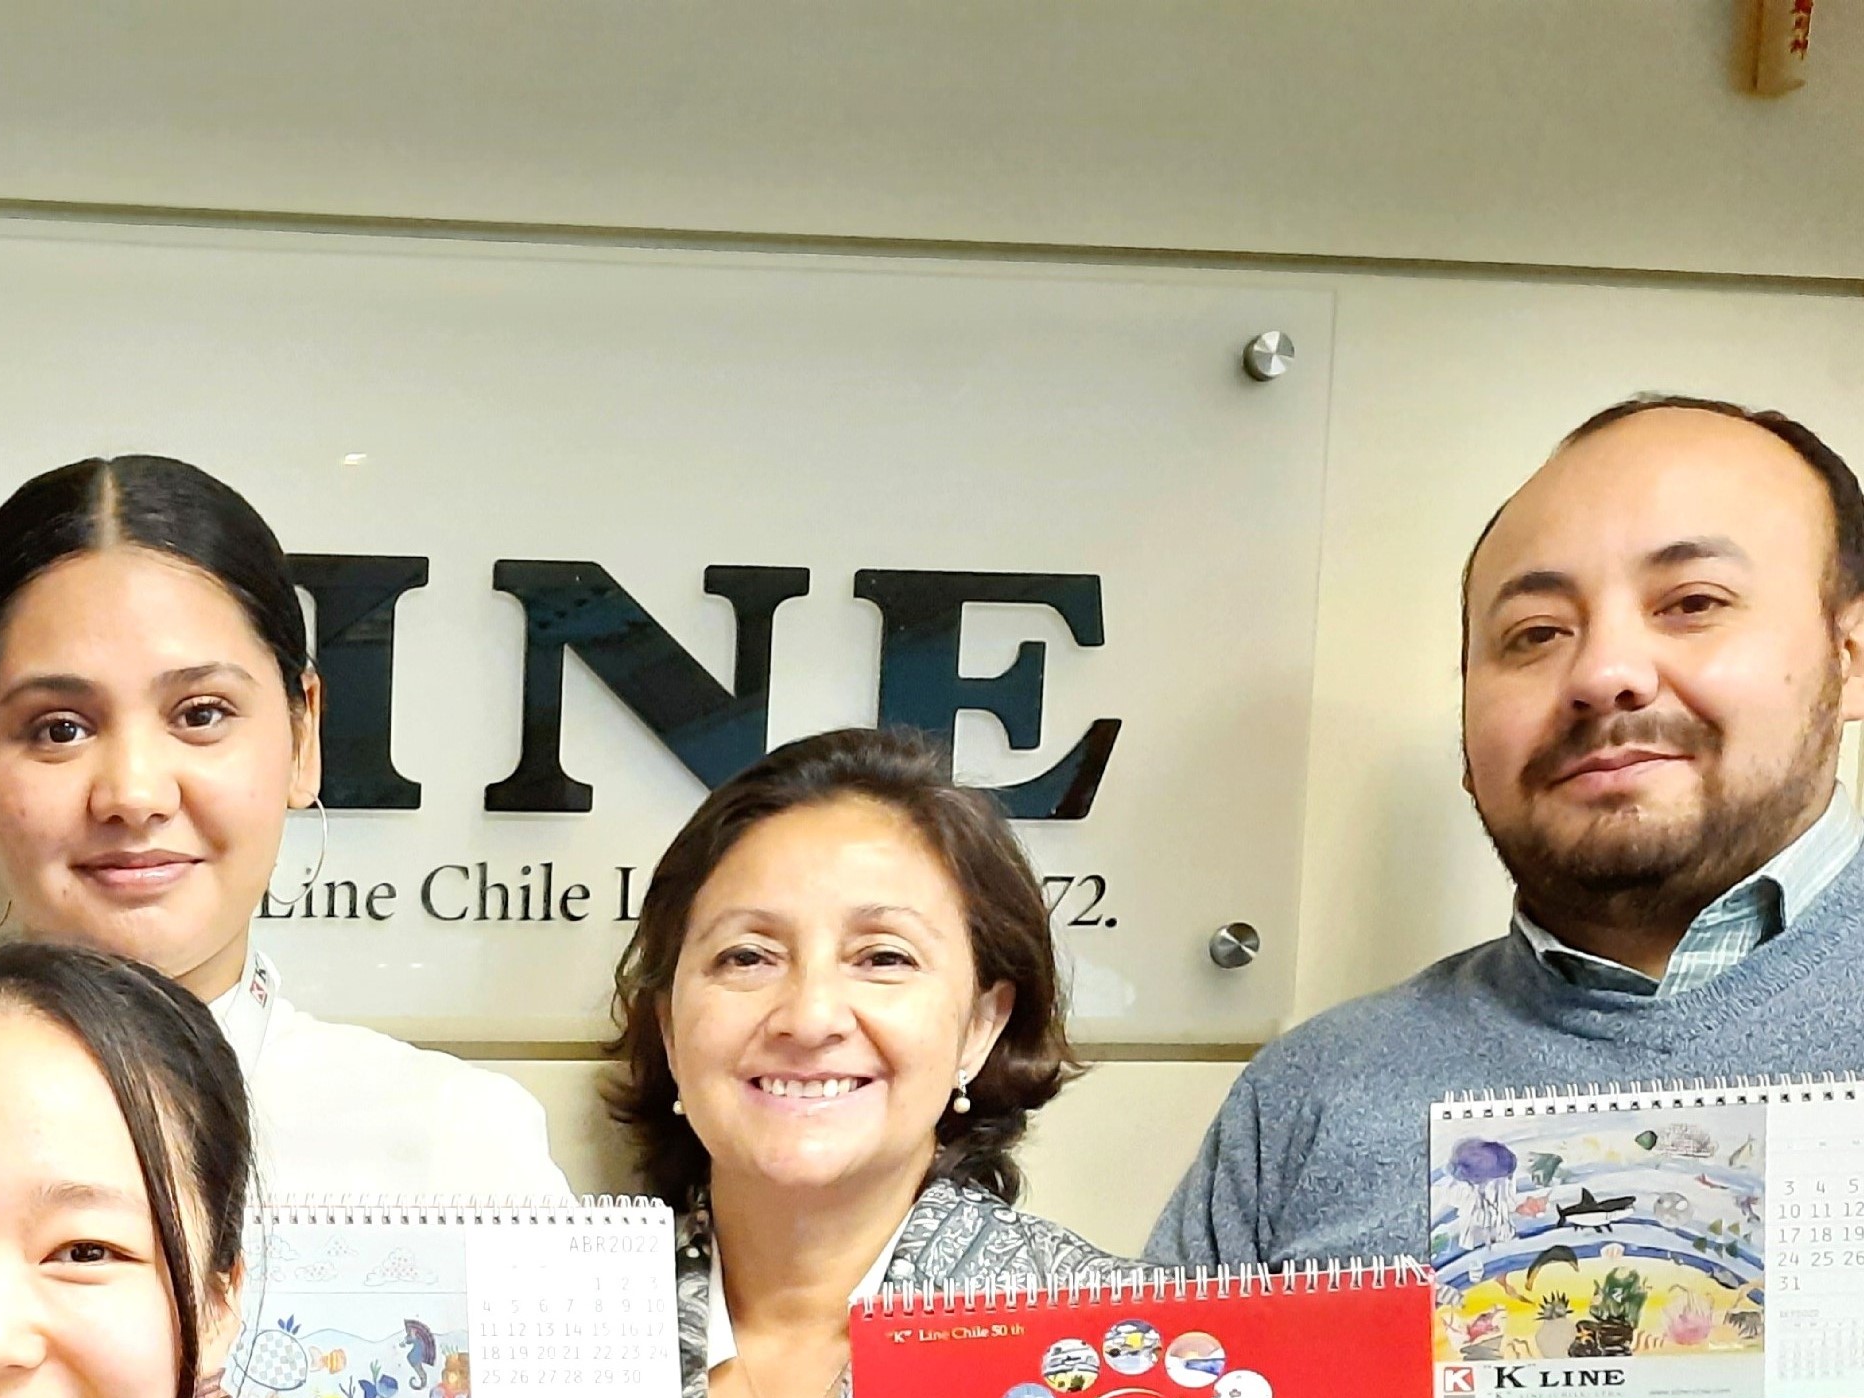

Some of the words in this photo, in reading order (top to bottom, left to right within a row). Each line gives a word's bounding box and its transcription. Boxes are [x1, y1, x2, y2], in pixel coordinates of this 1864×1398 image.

[420, 861, 591, 922] Chile
[1784, 1181, 1794, 1196] 3
[1816, 1181, 1825, 1194] 4
[1849, 1178, 1858, 1193] 5
[1778, 1204, 1800, 1219] 10
[1811, 1203, 1831, 1218] 11
[1779, 1227, 1800, 1243] 17
[1810, 1227, 1832, 1243] 18
[569, 1235, 659, 1253] ABR2022
[1777, 1252, 1799, 1267] 24
[1811, 1251, 1833, 1267] 25
[1779, 1276, 1800, 1291] 31
[483, 1300, 490, 1313] 4
[512, 1300, 519, 1313] 5
[539, 1299, 548, 1312] 6
[568, 1299, 573, 1312] 7
[595, 1299, 603, 1312] 8
[622, 1299, 630, 1312] 9
[481, 1323, 498, 1336] 11
[508, 1323, 526, 1336] 12
[537, 1323, 554, 1336] 13
[565, 1323, 581, 1336] 14
[919, 1329, 950, 1342] Line
[951, 1325, 990, 1339] Chile
[991, 1324, 1008, 1337] 50
[1011, 1323, 1025, 1336] th
[482, 1346, 500, 1360] 18
[510, 1346, 528, 1360] 19
[538, 1346, 555, 1359] 20
[563, 1346, 580, 1359] 21
[482, 1370, 500, 1384] 25
[510, 1370, 528, 1384] 26
[539, 1370, 556, 1384] 27
[564, 1370, 583, 1384] 28
[594, 1370, 613, 1384] 29
[623, 1370, 640, 1383] 30
[1444, 1369, 1472, 1391] K
[1538, 1368, 1626, 1388] LINE
